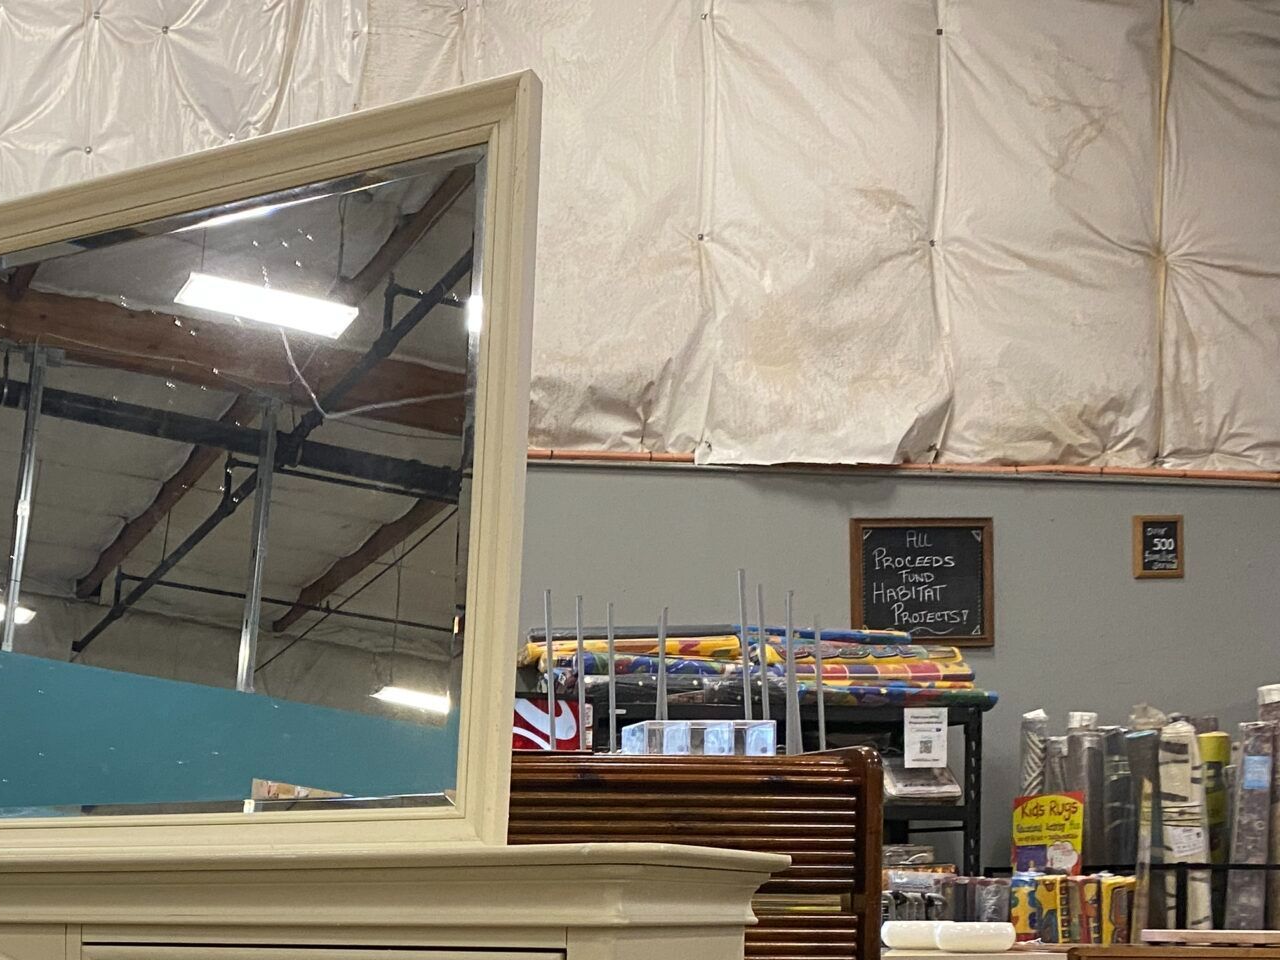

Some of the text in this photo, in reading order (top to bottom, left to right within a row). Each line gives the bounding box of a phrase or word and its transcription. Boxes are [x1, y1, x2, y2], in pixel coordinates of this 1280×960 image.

[1152, 538, 1175, 550] 500
[872, 547, 956, 570] PROCEEDS
[898, 569, 935, 583] FUND
[873, 582, 948, 604] HABITAT
[890, 602, 969, 626] PROJECTS!
[1021, 800, 1078, 821] Kids Rugs
